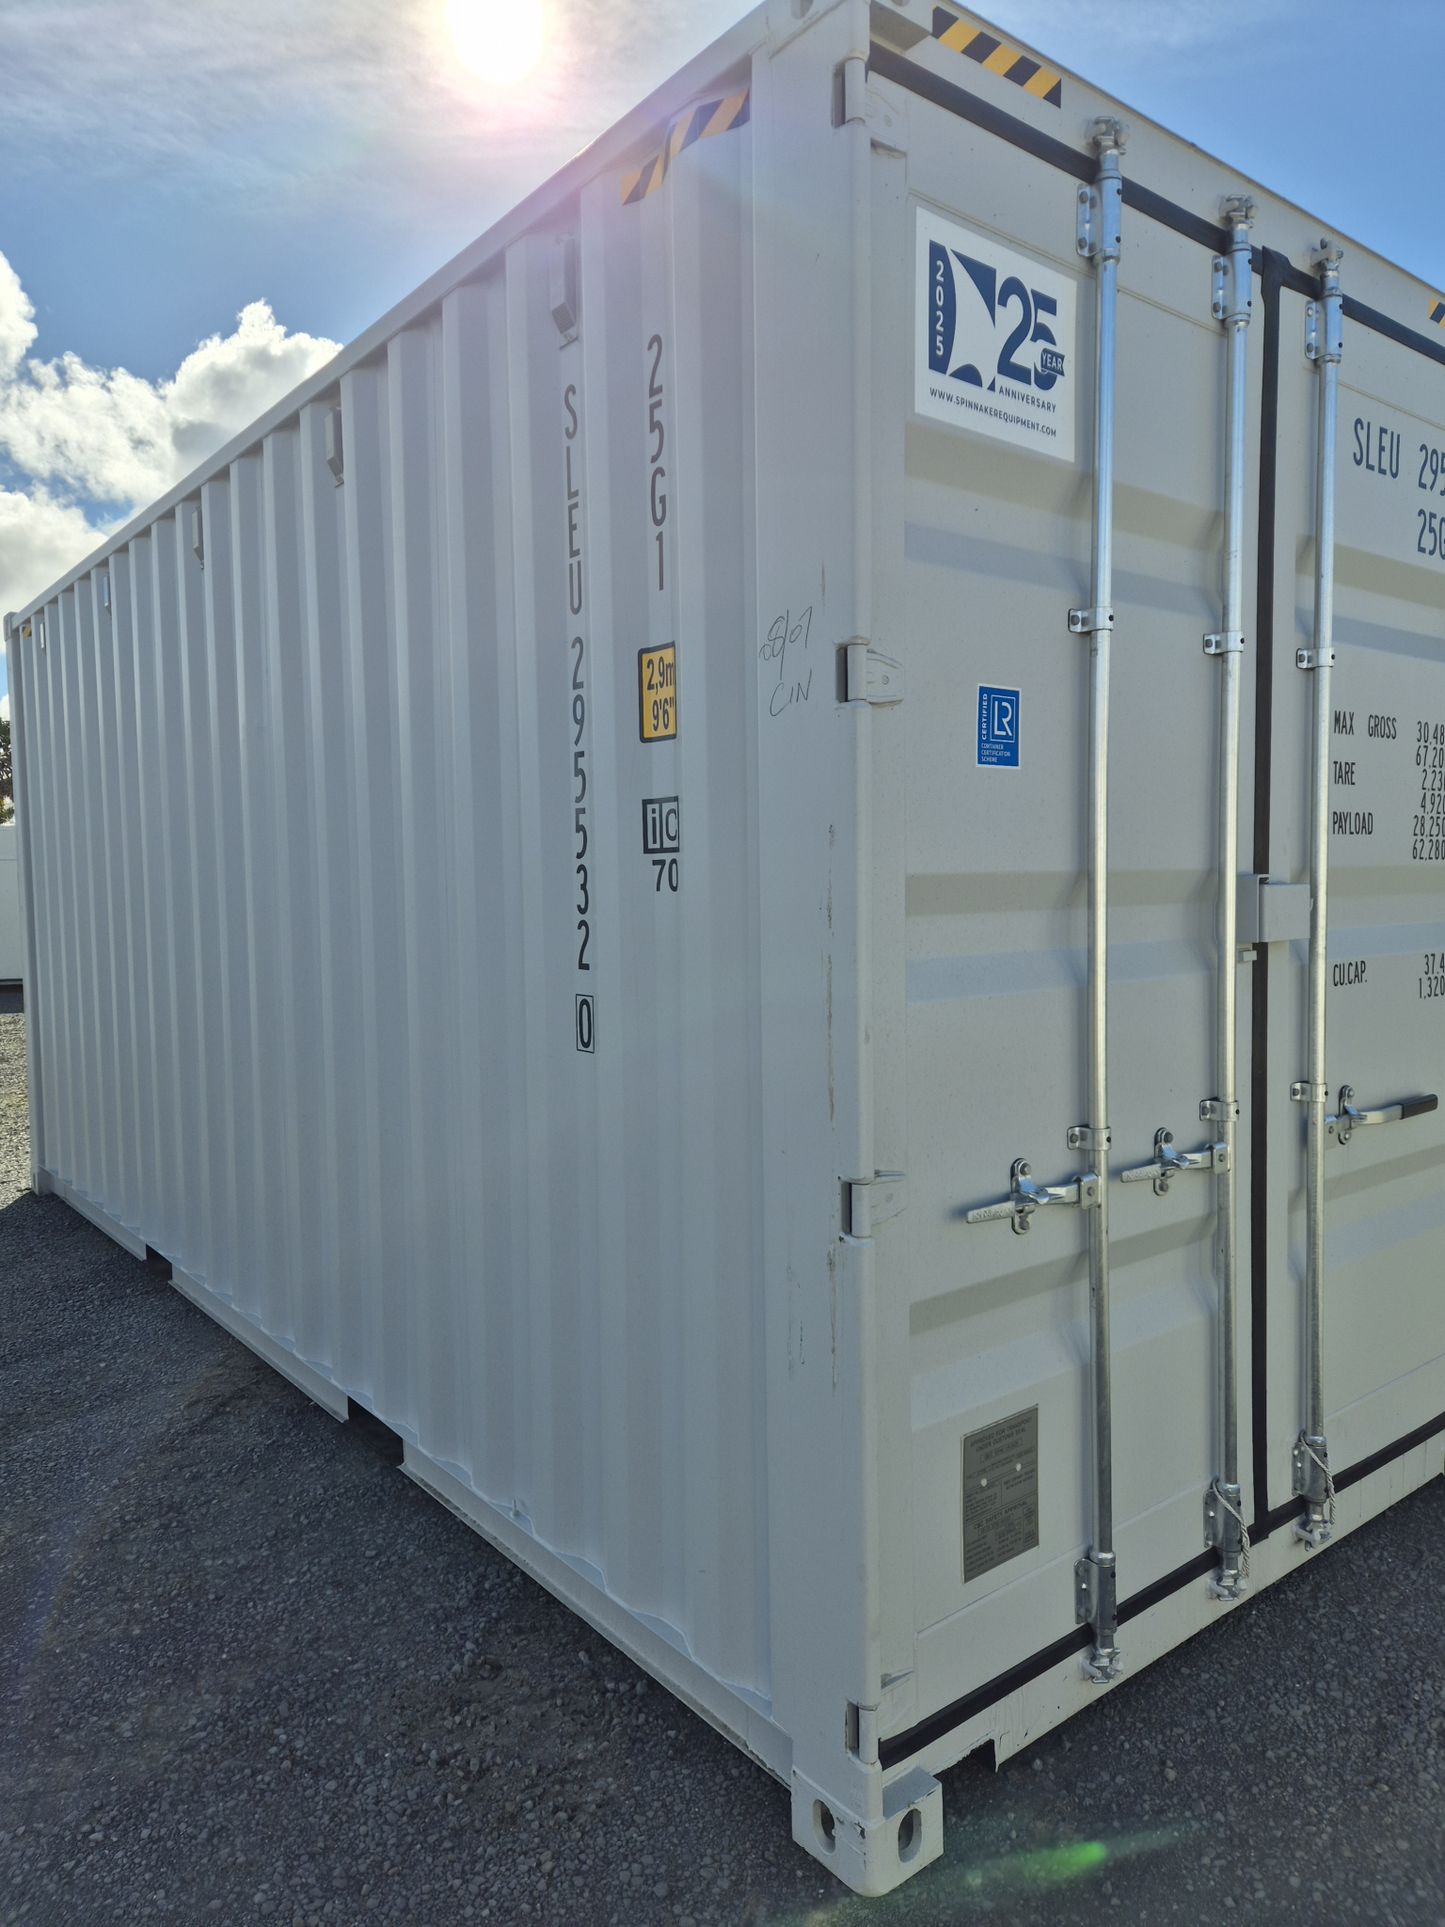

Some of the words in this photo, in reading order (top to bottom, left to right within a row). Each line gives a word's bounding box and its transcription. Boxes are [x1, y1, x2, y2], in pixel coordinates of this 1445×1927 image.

[935, 260, 945, 358] 2025
[997, 276, 1058, 391] 25
[1041, 350, 1064, 372] YEAR
[930, 387, 1057, 437] WWW.SPINNAKEREQUIPMENT.COM
[999, 385, 1057, 413] ANNIVERSARY
[647, 334, 667, 591] 25G1
[1353, 417, 1401, 479] SLEU
[564, 383, 583, 616] SLEU
[1333, 710, 1355, 735] MAX
[1367, 714, 1397, 739] GROSS
[981, 749, 1011, 757] CERTIFICATION
[1333, 761, 1356, 785] TARE
[1421, 768, 1445, 792] 2,23
[571, 636, 590, 971] 295532
[1332, 811, 1374, 835] PAYLOAD
[652, 858, 679, 892] 70
[1333, 960, 1368, 987] CU.CAP.
